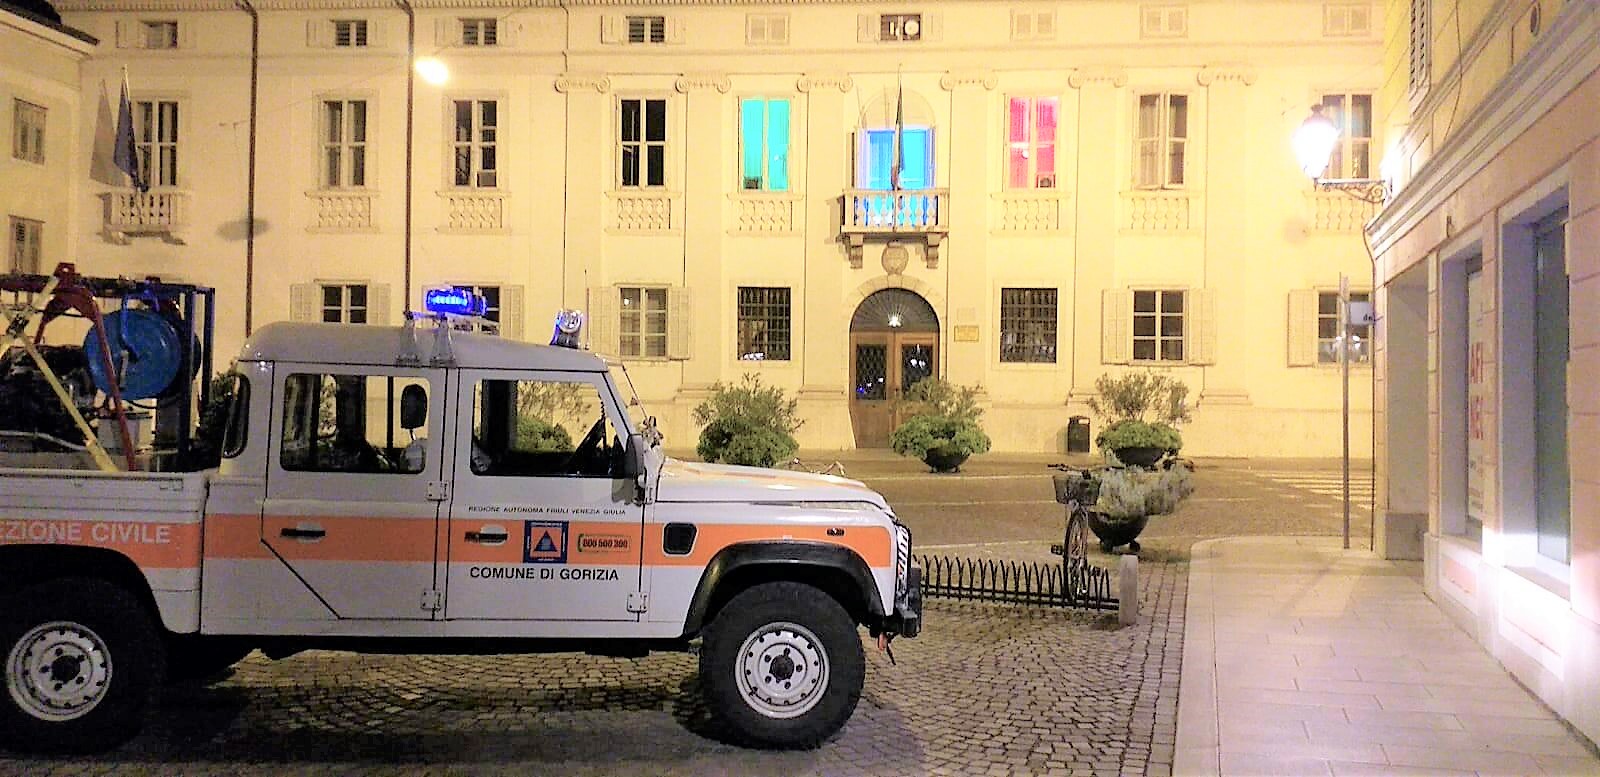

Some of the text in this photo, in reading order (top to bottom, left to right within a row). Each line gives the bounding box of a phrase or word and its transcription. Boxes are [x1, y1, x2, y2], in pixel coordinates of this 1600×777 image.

[572, 507, 600, 515] VENEZIA
[603, 508, 626, 516] GIULIA
[91, 523, 171, 544] CIVILE
[470, 566, 619, 581] COMUNE DI GORIZIA
